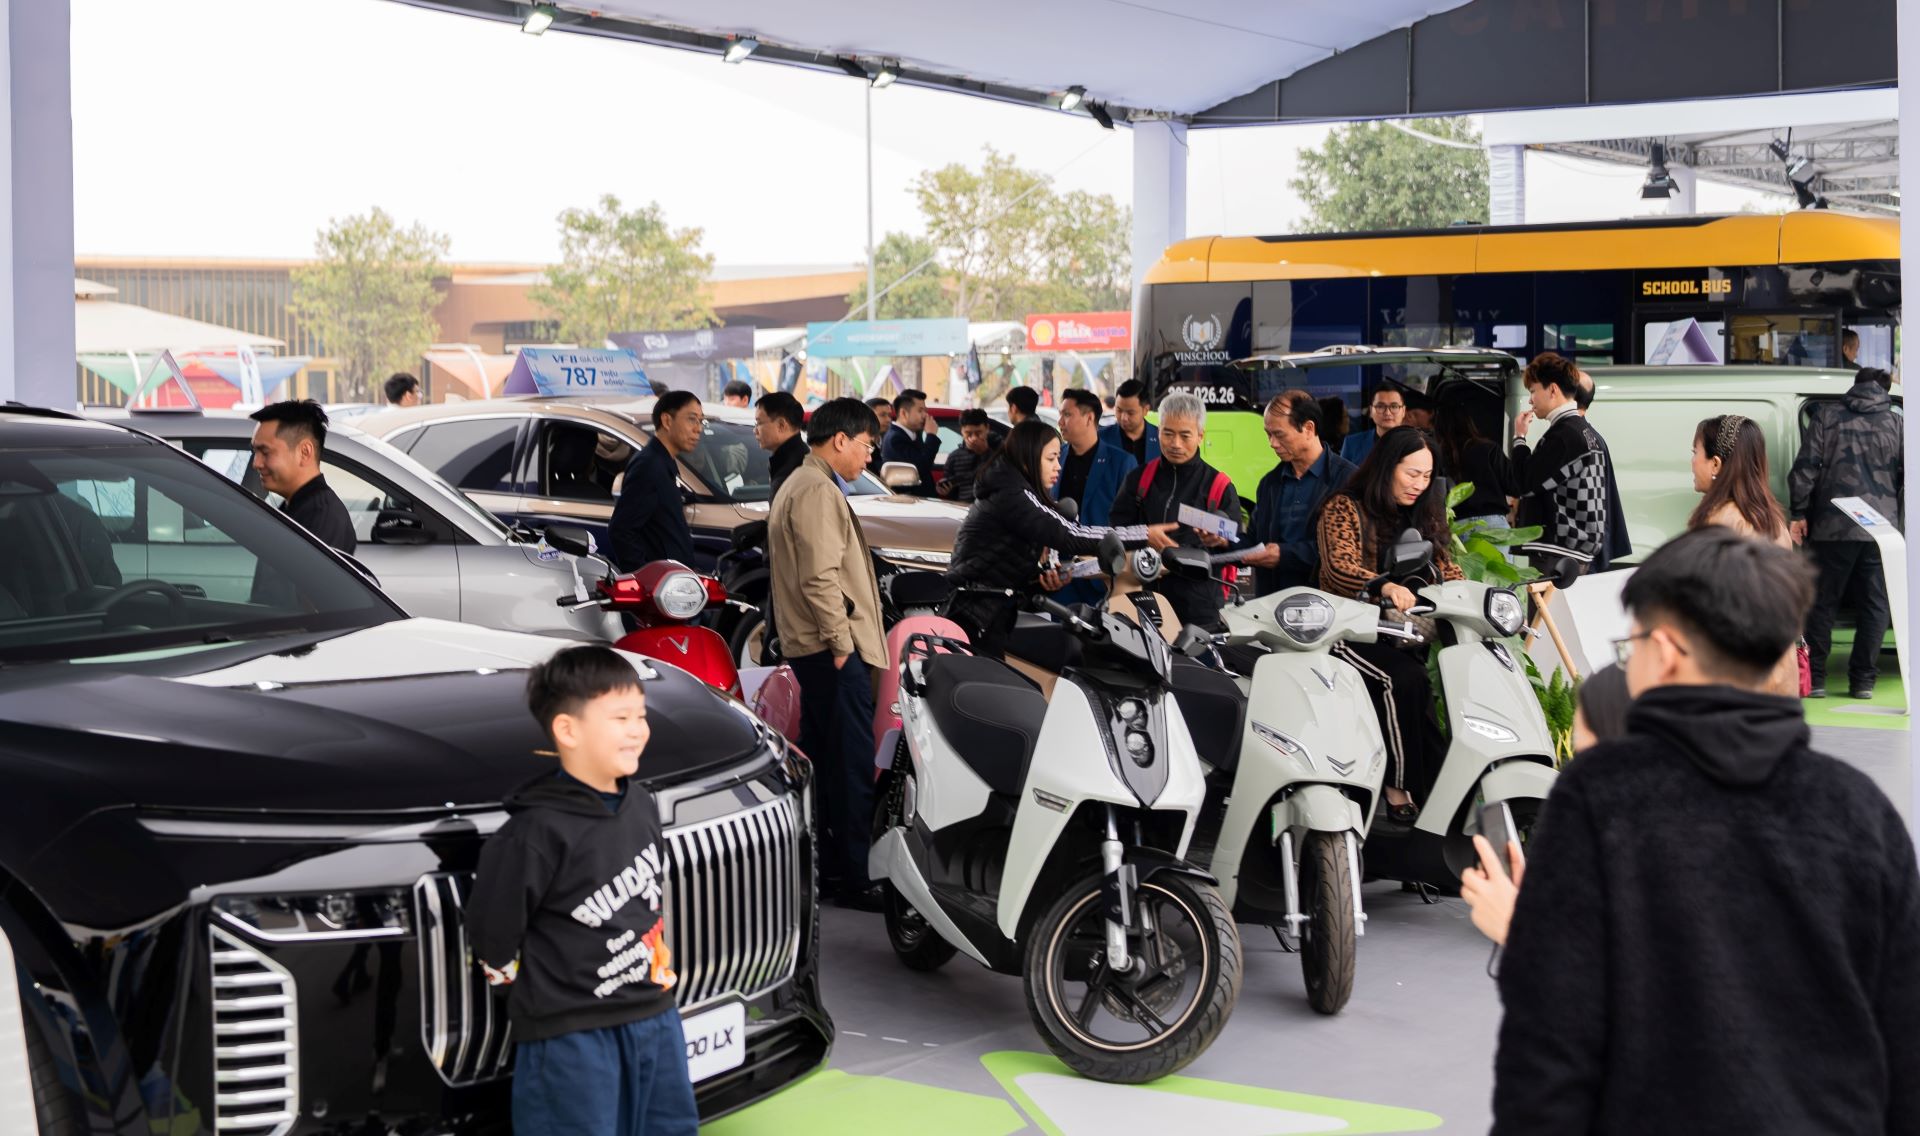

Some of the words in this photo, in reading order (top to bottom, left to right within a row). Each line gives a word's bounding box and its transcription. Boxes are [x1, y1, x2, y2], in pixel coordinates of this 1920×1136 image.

[1642, 280, 1699, 295] SCHOOL
[1701, 279, 1732, 294] BUS
[552, 354, 569, 364] VF
[1174, 350, 1231, 361] VINSCHOOL
[561, 367, 596, 386] 787
[571, 843, 661, 928] BULIDAY
[713, 1026, 735, 1051] LX
